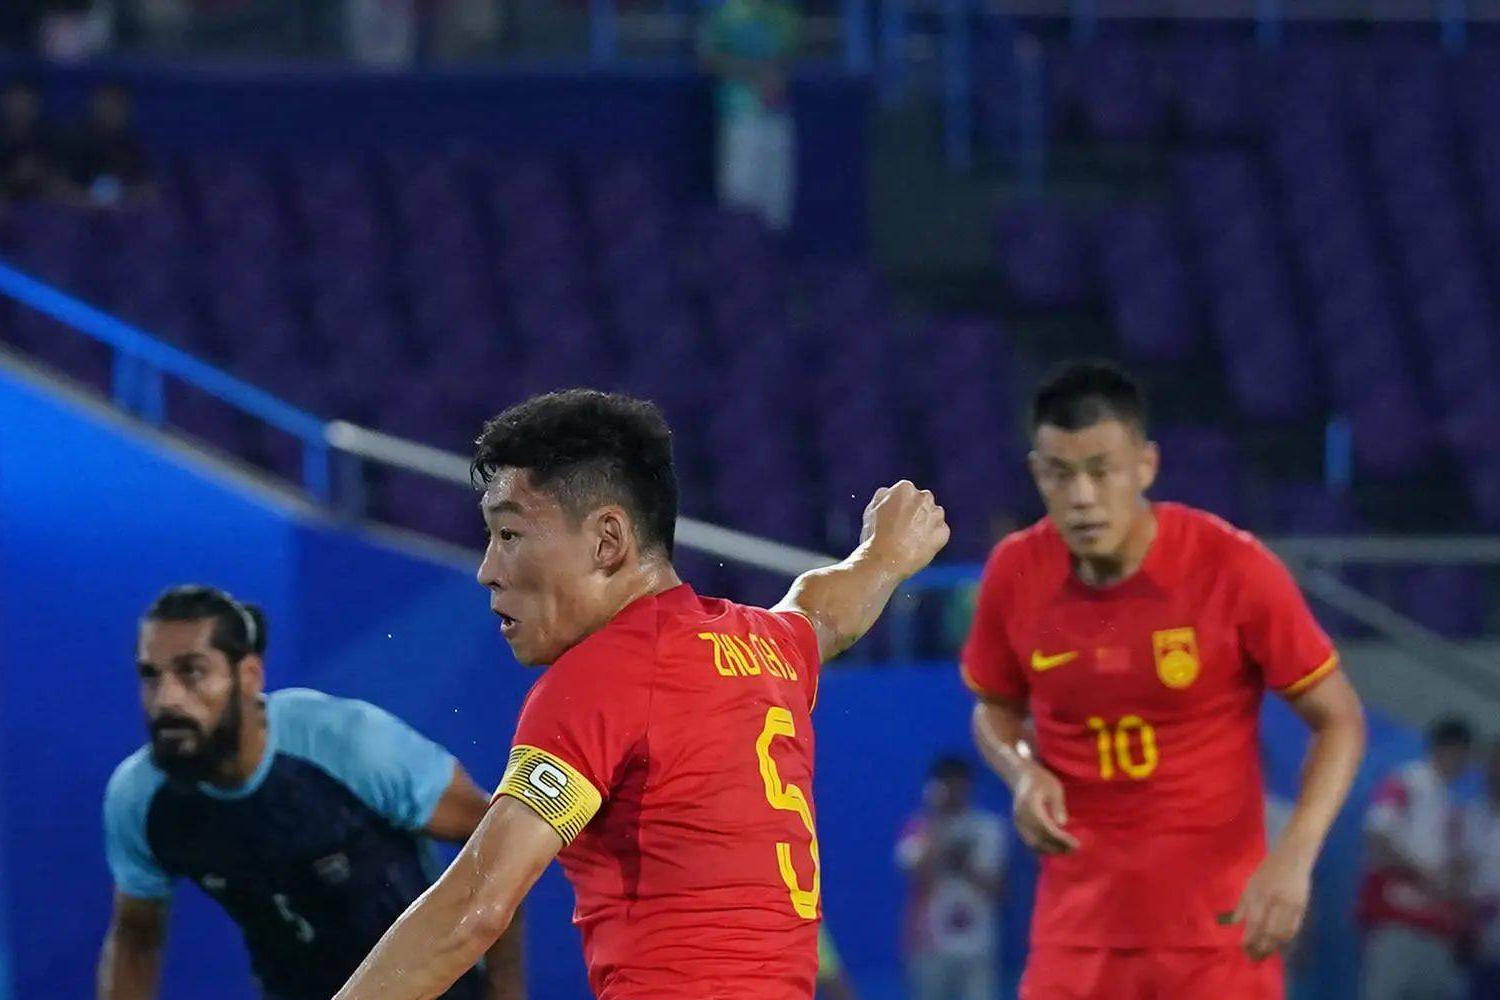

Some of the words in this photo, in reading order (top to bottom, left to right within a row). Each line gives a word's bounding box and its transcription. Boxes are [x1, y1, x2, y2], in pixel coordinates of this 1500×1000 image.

[529, 761, 567, 799] C
[1088, 715, 1159, 780] 10
[756, 706, 820, 919] 5
